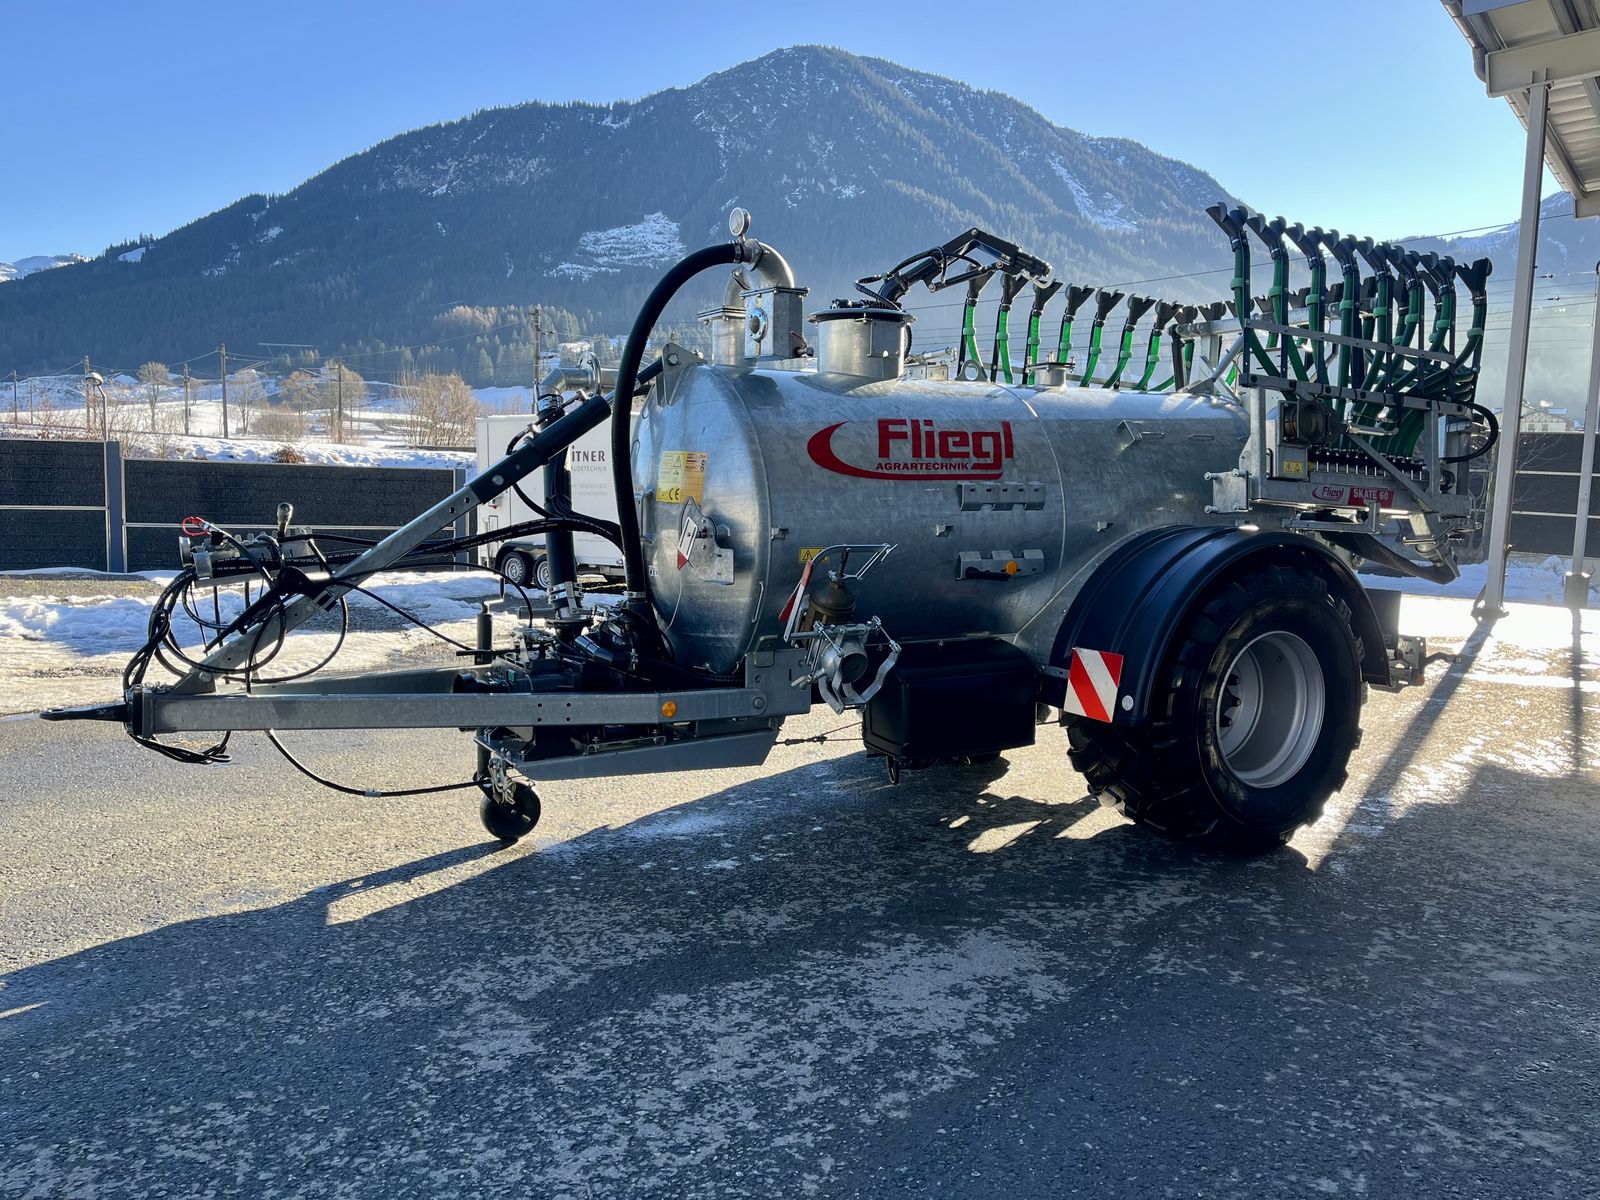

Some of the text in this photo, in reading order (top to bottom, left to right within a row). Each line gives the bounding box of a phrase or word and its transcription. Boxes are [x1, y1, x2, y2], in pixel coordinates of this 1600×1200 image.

[878, 418, 1014, 470] Fliegl
[876, 462, 969, 471] AGRARTECHNIK
[1353, 488, 1389, 501] SKATE 60
